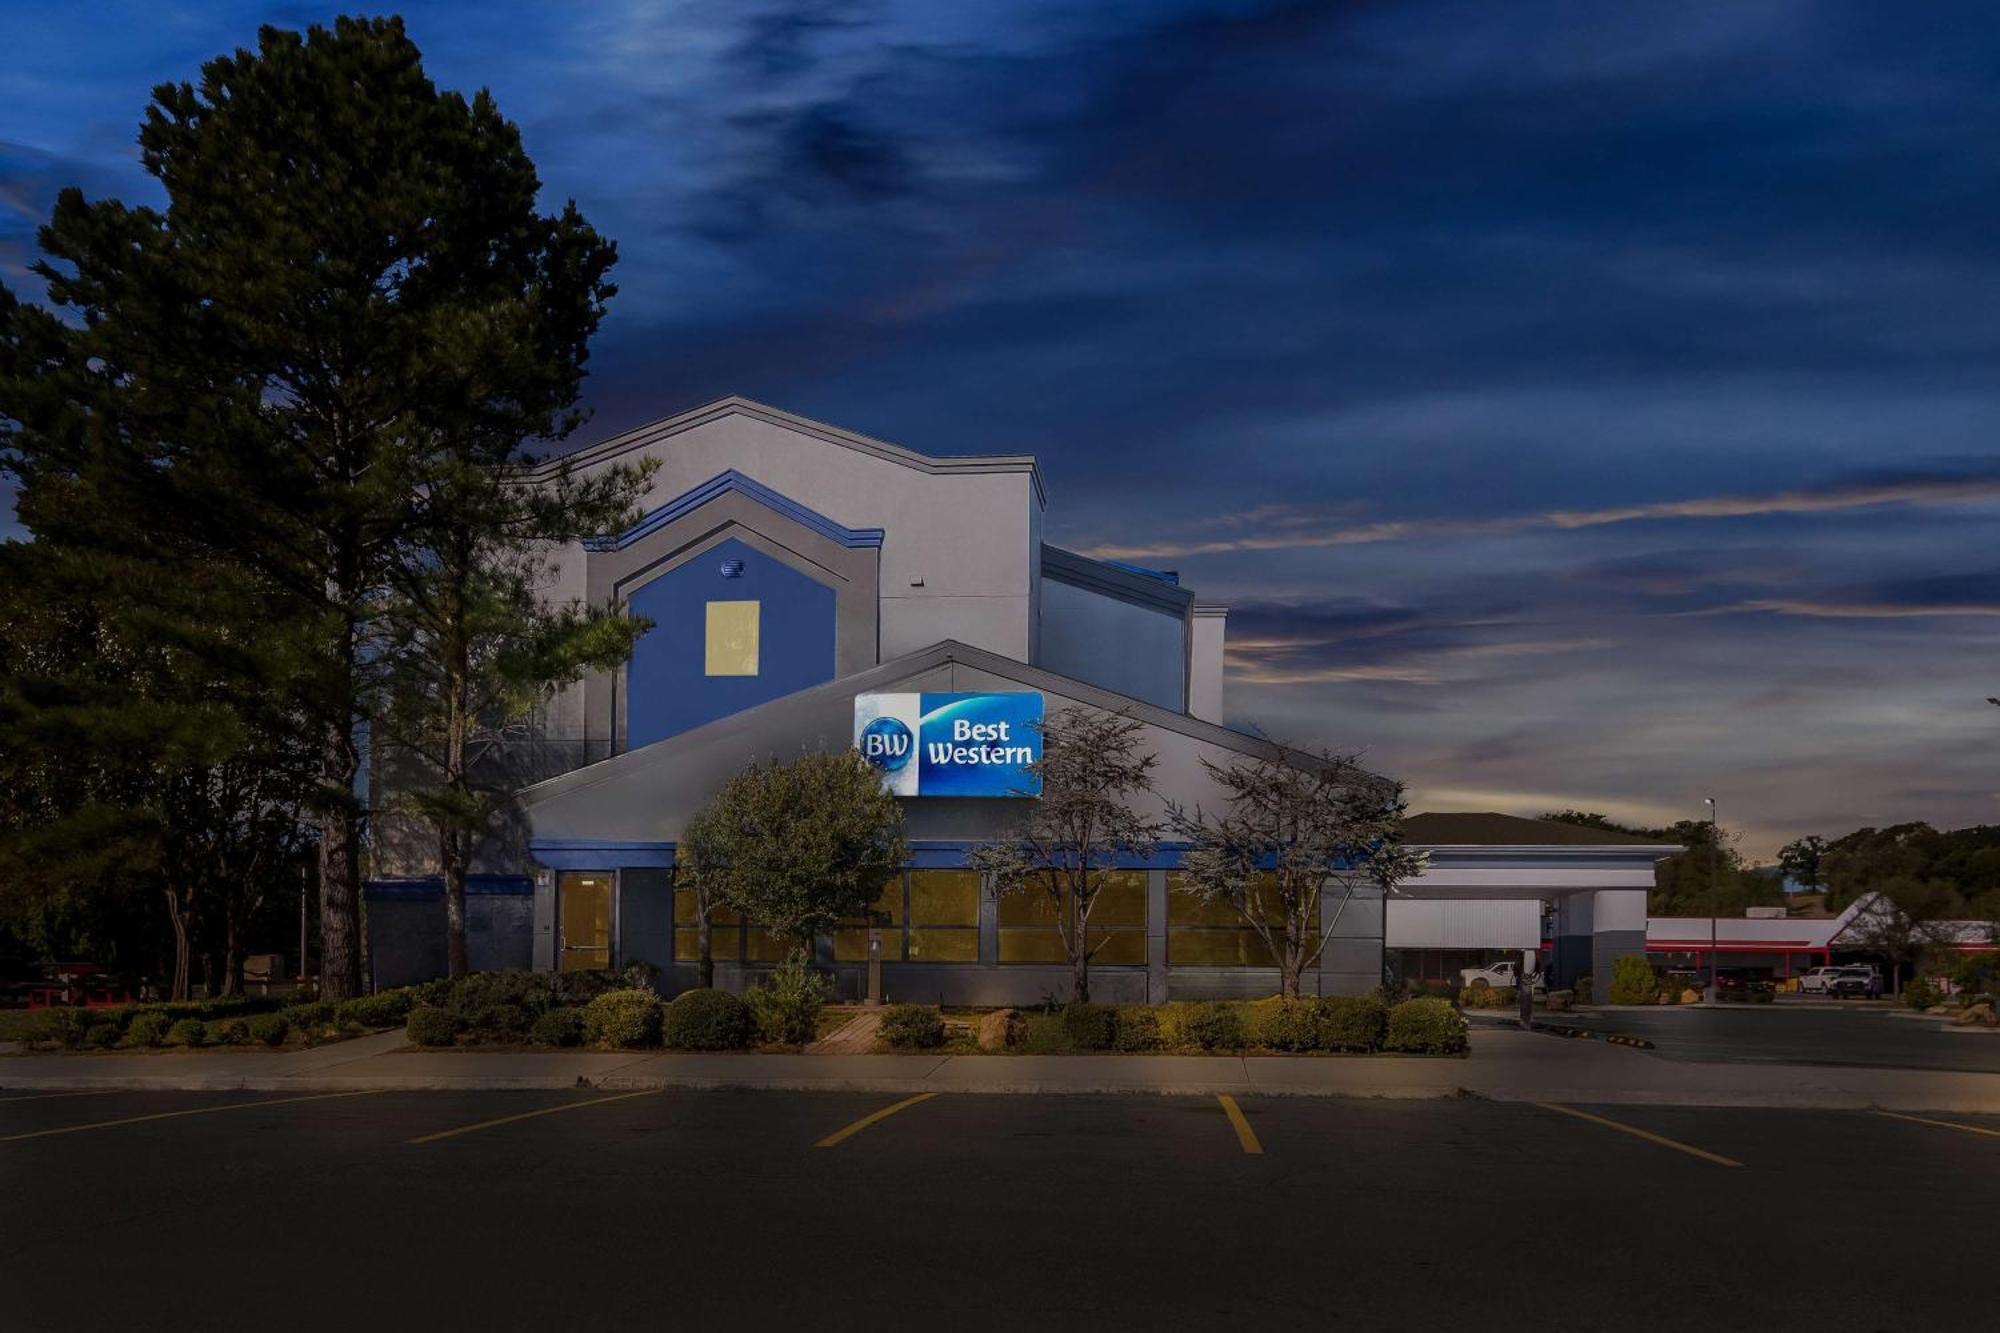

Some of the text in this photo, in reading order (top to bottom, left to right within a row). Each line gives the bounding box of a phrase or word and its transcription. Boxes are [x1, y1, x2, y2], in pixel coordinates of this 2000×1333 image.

[954, 719, 1010, 741] Best
[867, 734, 908, 756] BW
[928, 742, 1032, 764] Western
